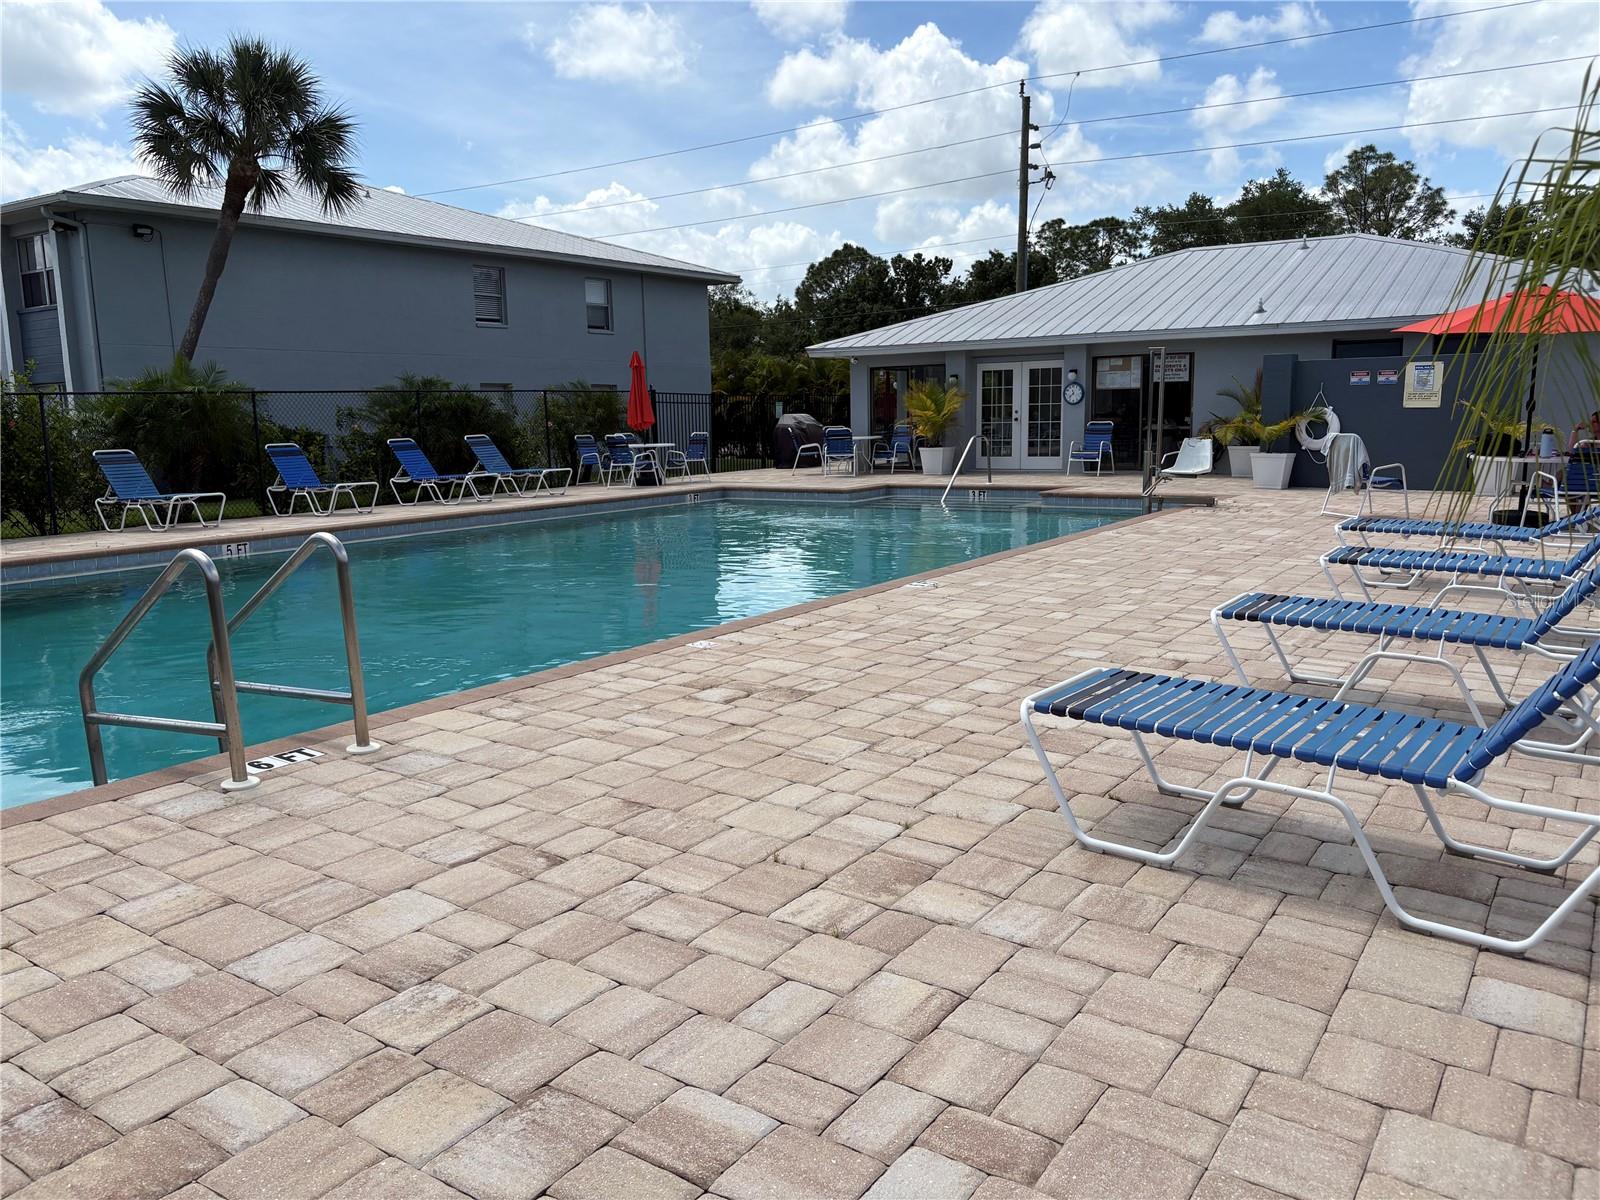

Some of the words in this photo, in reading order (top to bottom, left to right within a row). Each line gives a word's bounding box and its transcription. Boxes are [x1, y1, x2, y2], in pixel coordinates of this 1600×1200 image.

[693, 494, 699, 503] FT
[978, 490, 987, 500] FT
[226, 544, 233, 556] 5
[236, 542, 248, 556] FT
[247, 760, 275, 770] 6
[273, 748, 317, 763] FT
